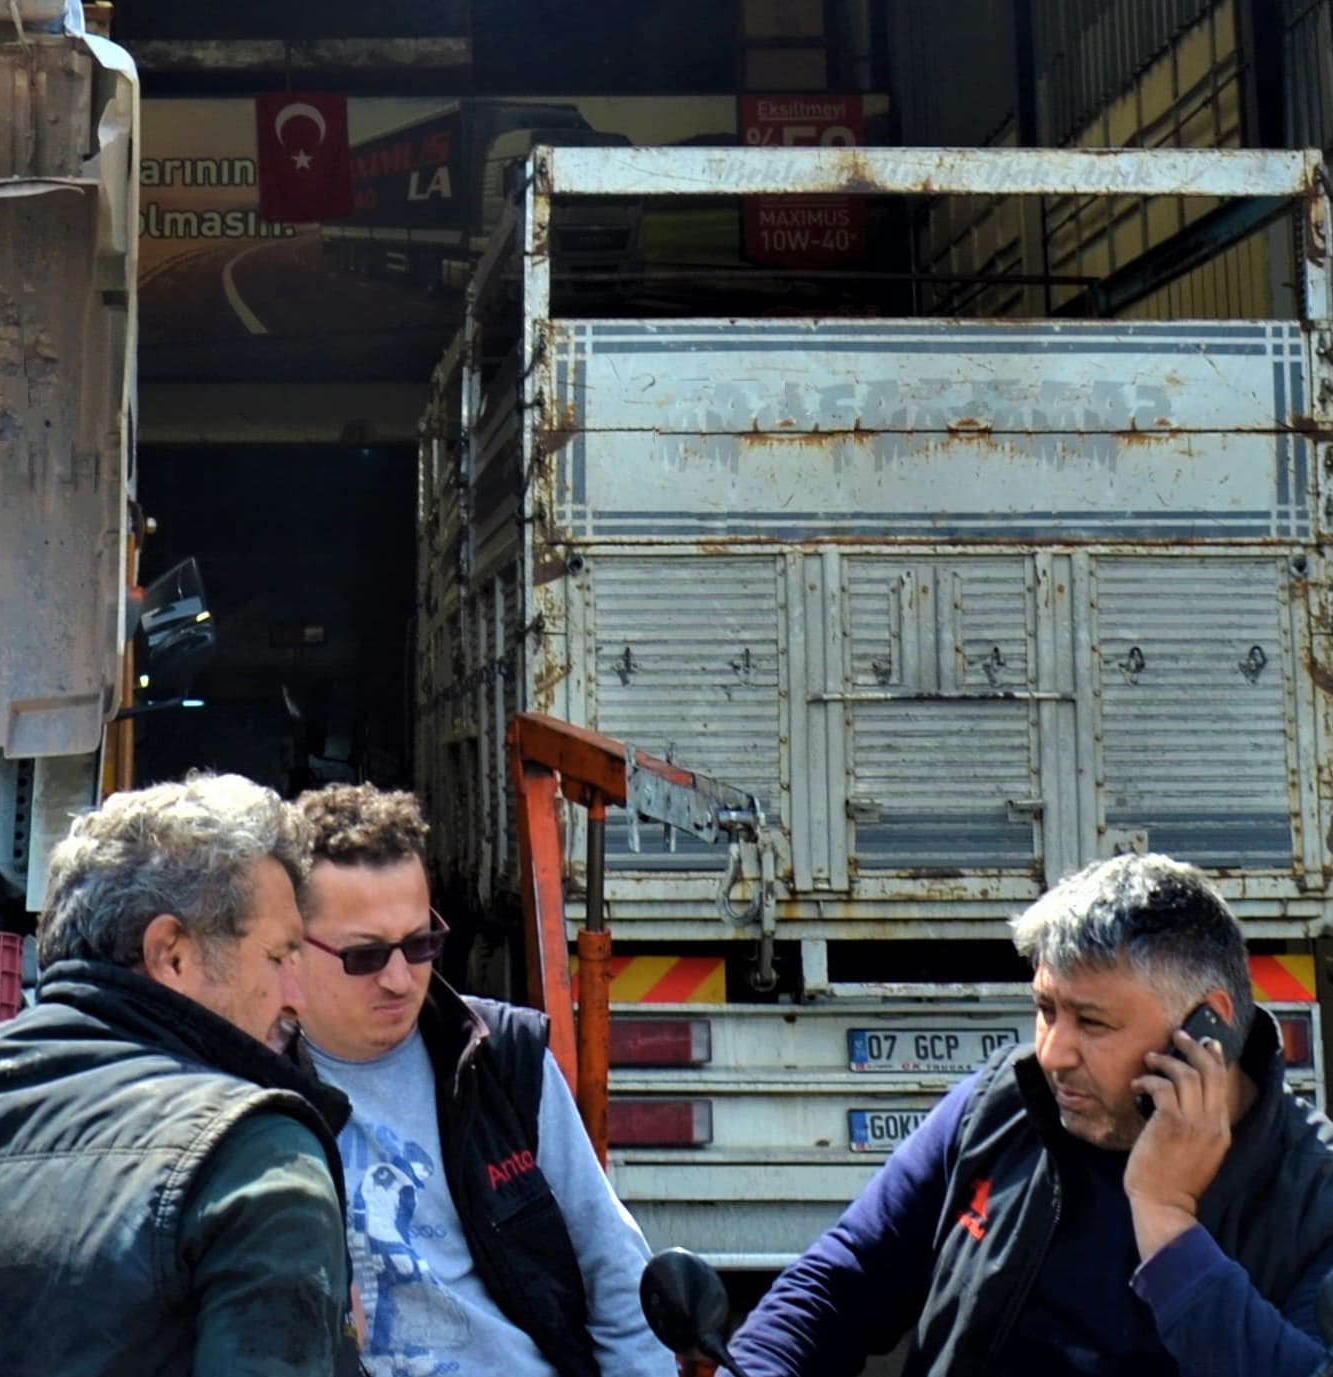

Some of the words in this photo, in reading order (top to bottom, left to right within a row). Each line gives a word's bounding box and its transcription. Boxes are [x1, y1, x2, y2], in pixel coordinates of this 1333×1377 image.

[407, 168, 452, 201] LA
[758, 208, 851, 227] MAXIMUS
[868, 1034, 897, 1061] 07
[914, 1034, 959, 1061] GCP
